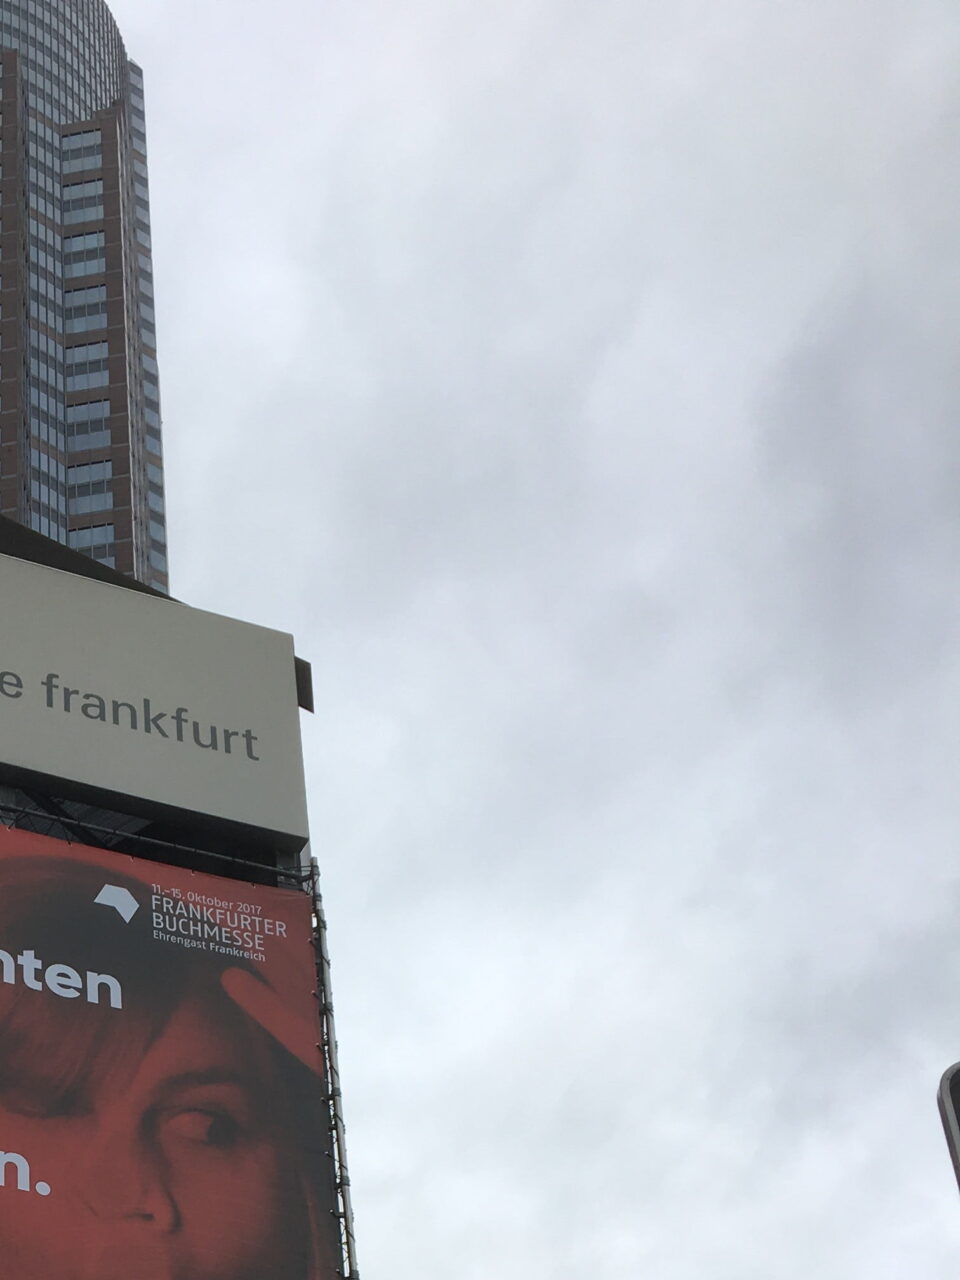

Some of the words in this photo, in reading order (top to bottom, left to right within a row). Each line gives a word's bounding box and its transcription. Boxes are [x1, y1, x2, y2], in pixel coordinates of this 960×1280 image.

[40, 673, 260, 762] frankfurt
[151, 894, 288, 938] FRANKFURTER
[187, 891, 234, 911] Oktober
[237, 901, 262, 915] 2017
[152, 912, 265, 951] BUCHMESSE
[153, 929, 206, 949] Ehrengast
[209, 942, 266, 962] Frankreich
